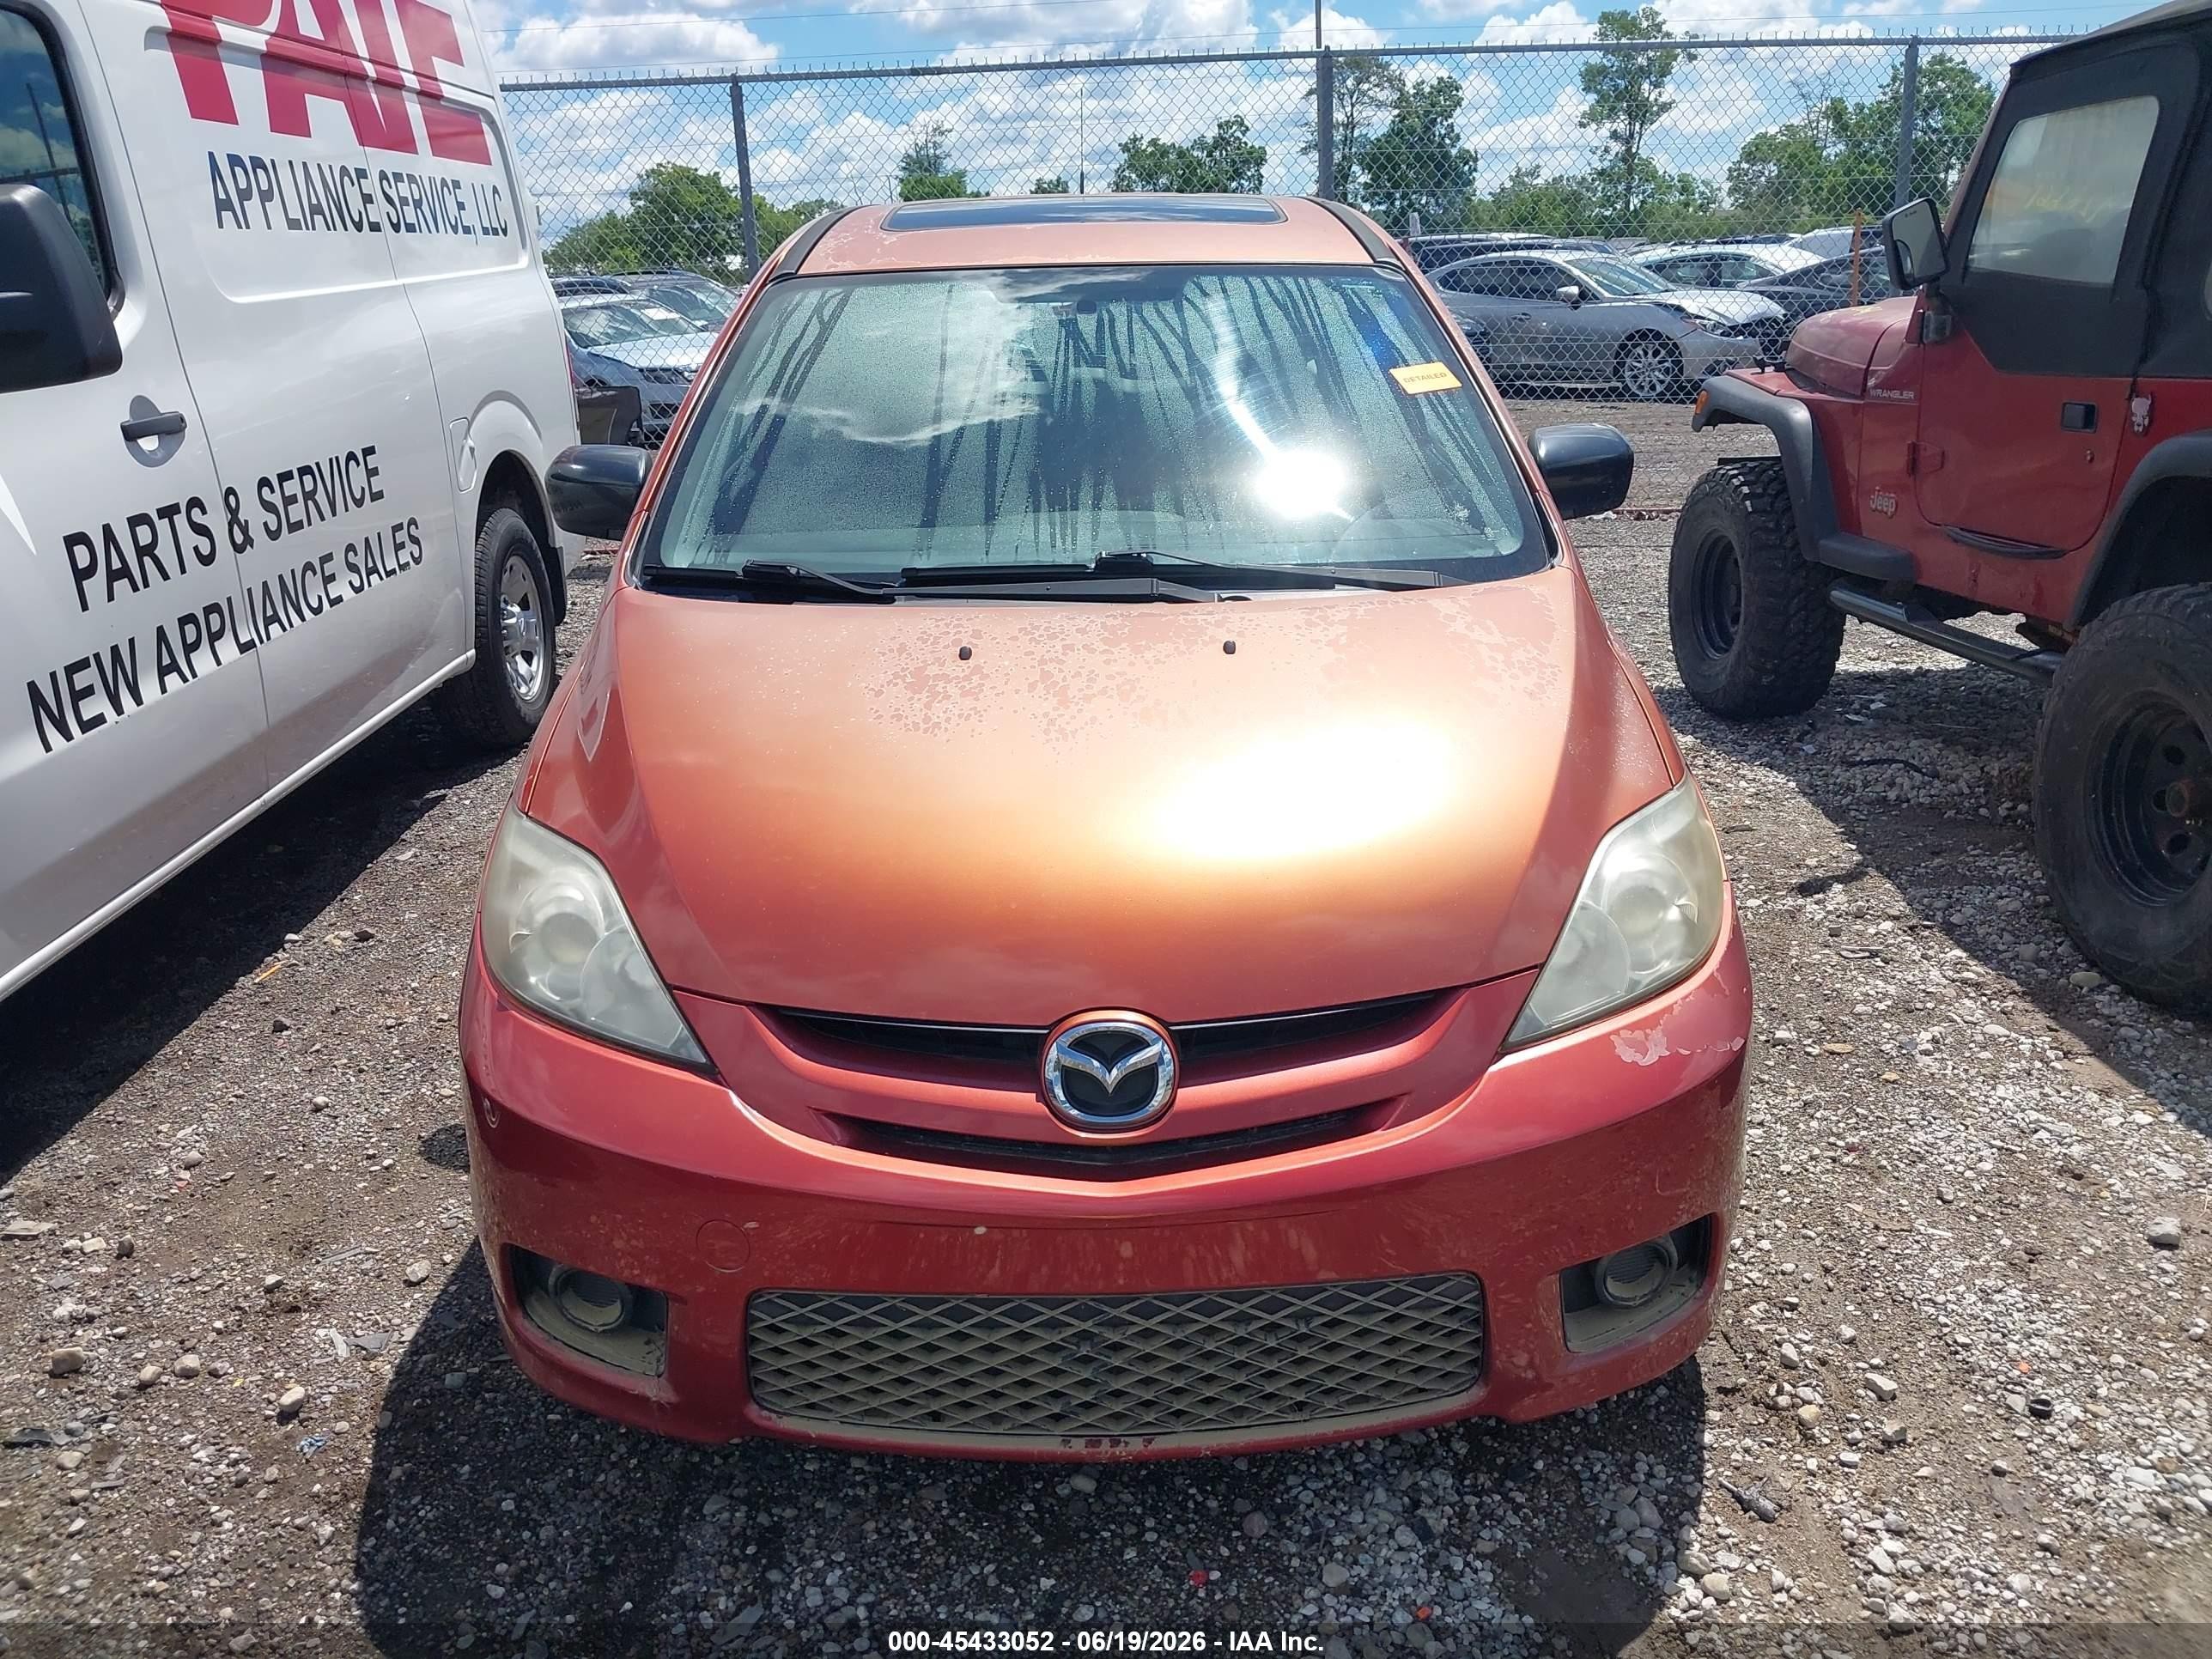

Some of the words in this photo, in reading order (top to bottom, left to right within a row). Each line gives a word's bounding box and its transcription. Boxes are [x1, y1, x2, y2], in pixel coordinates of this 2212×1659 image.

[207, 150, 382, 234] APPLIANCE
[378, 168, 478, 246] SERVICE,
[472, 182, 508, 238] LLC
[1403, 372, 1448, 383] DETAILED
[1870, 389, 1915, 399] WRANGLER
[63, 495, 218, 612] PARTS
[222, 486, 255, 554] &
[257, 445, 385, 541] SERVICE
[1870, 487, 1898, 517] Jeep
[26, 636, 145, 754] NEW
[155, 551, 344, 695] APPLIANCE
[344, 516, 424, 595] SALES
